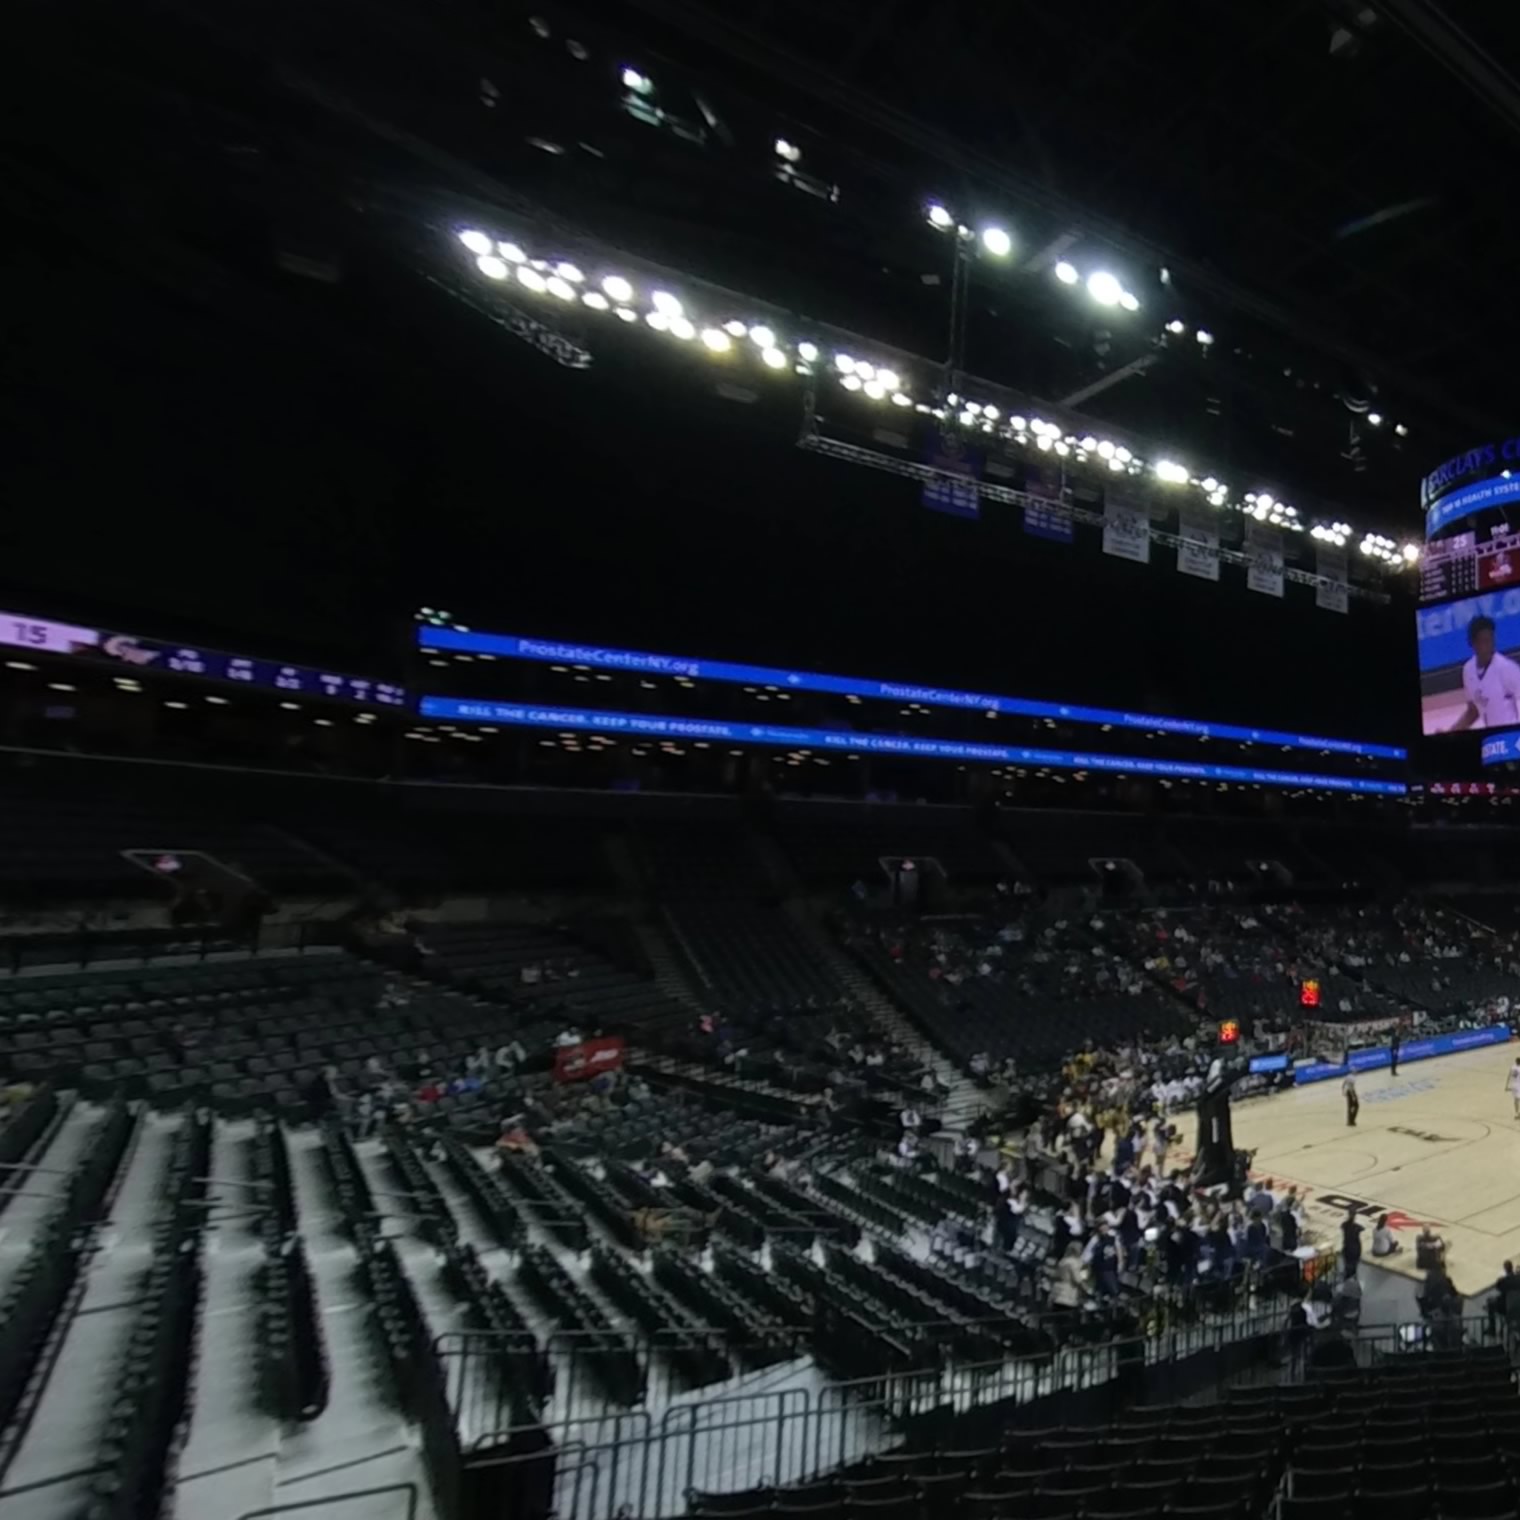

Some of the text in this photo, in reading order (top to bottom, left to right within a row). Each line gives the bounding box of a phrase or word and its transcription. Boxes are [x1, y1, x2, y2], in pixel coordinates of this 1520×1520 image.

[1453, 537, 1468, 550] 25
[12, 622, 47, 644] 15
[518, 640, 699, 676] ProstateCenterNY.org
[880, 683, 1000, 711] ProstateCenterNY.org
[458, 705, 492, 717] KILL
[495, 707, 525, 719] THE
[528, 709, 588, 724] CANCER.
[630, 718, 666, 732] YOUR
